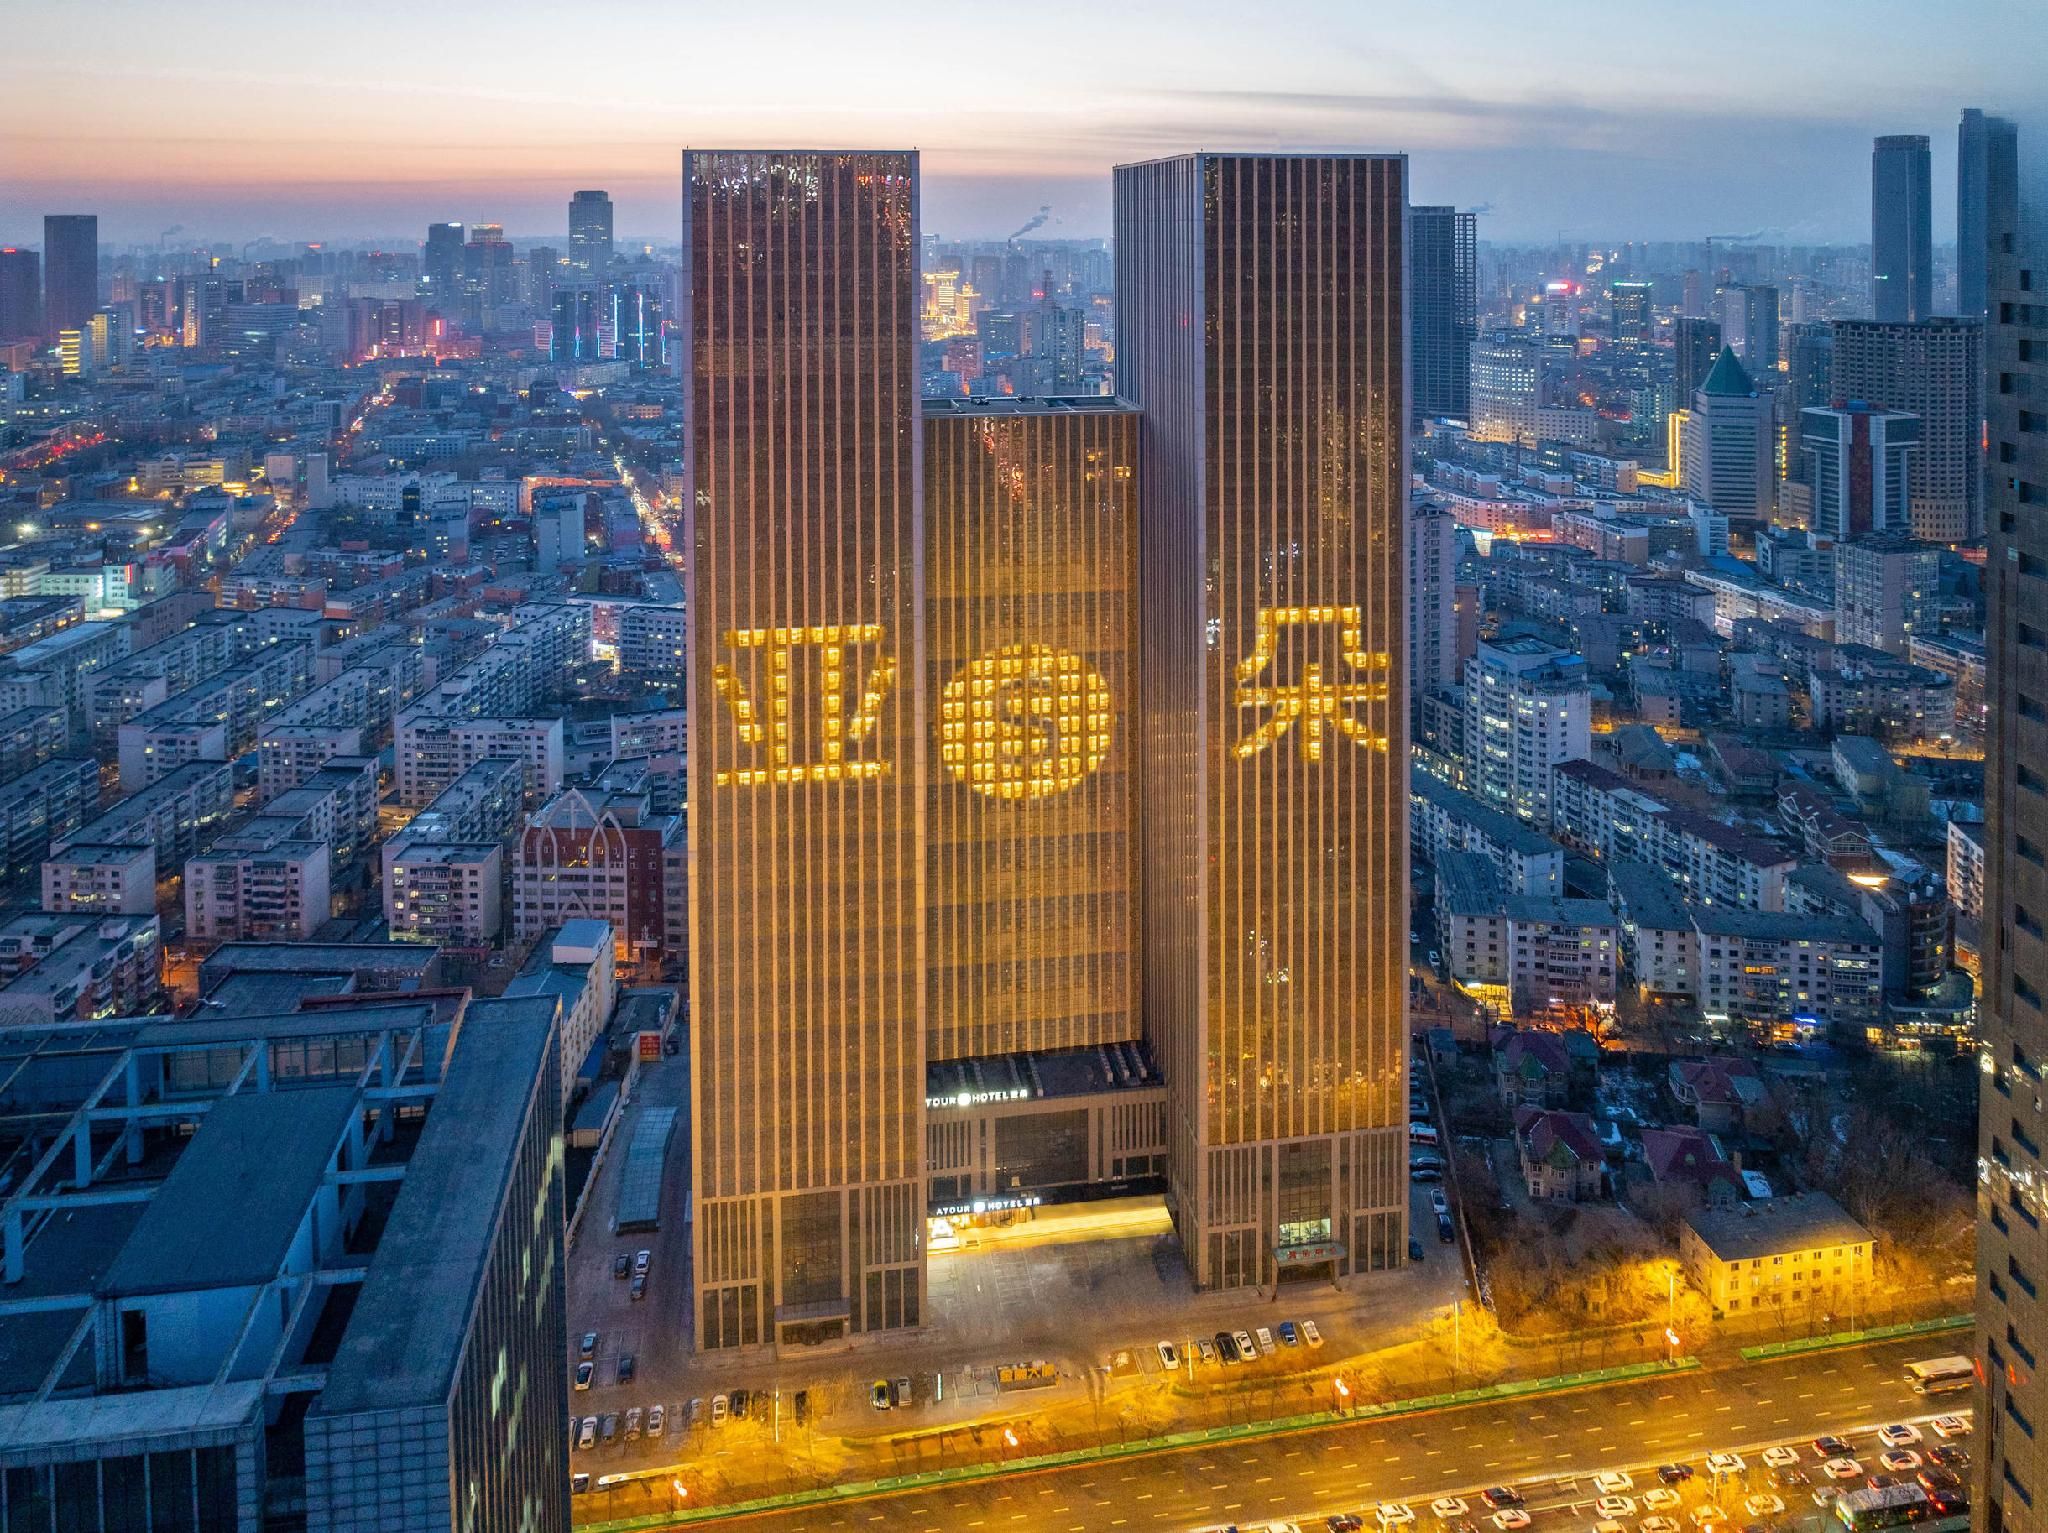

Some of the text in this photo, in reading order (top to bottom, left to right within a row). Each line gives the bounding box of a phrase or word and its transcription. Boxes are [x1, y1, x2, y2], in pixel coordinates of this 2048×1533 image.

[713, 605, 1391, 786] 亚 朵
[926, 1097, 957, 1108] TOUR
[971, 1091, 1008, 1104] HOTEL
[936, 1205, 971, 1216] ATOUR
[987, 1199, 1023, 1211] HOTEL
